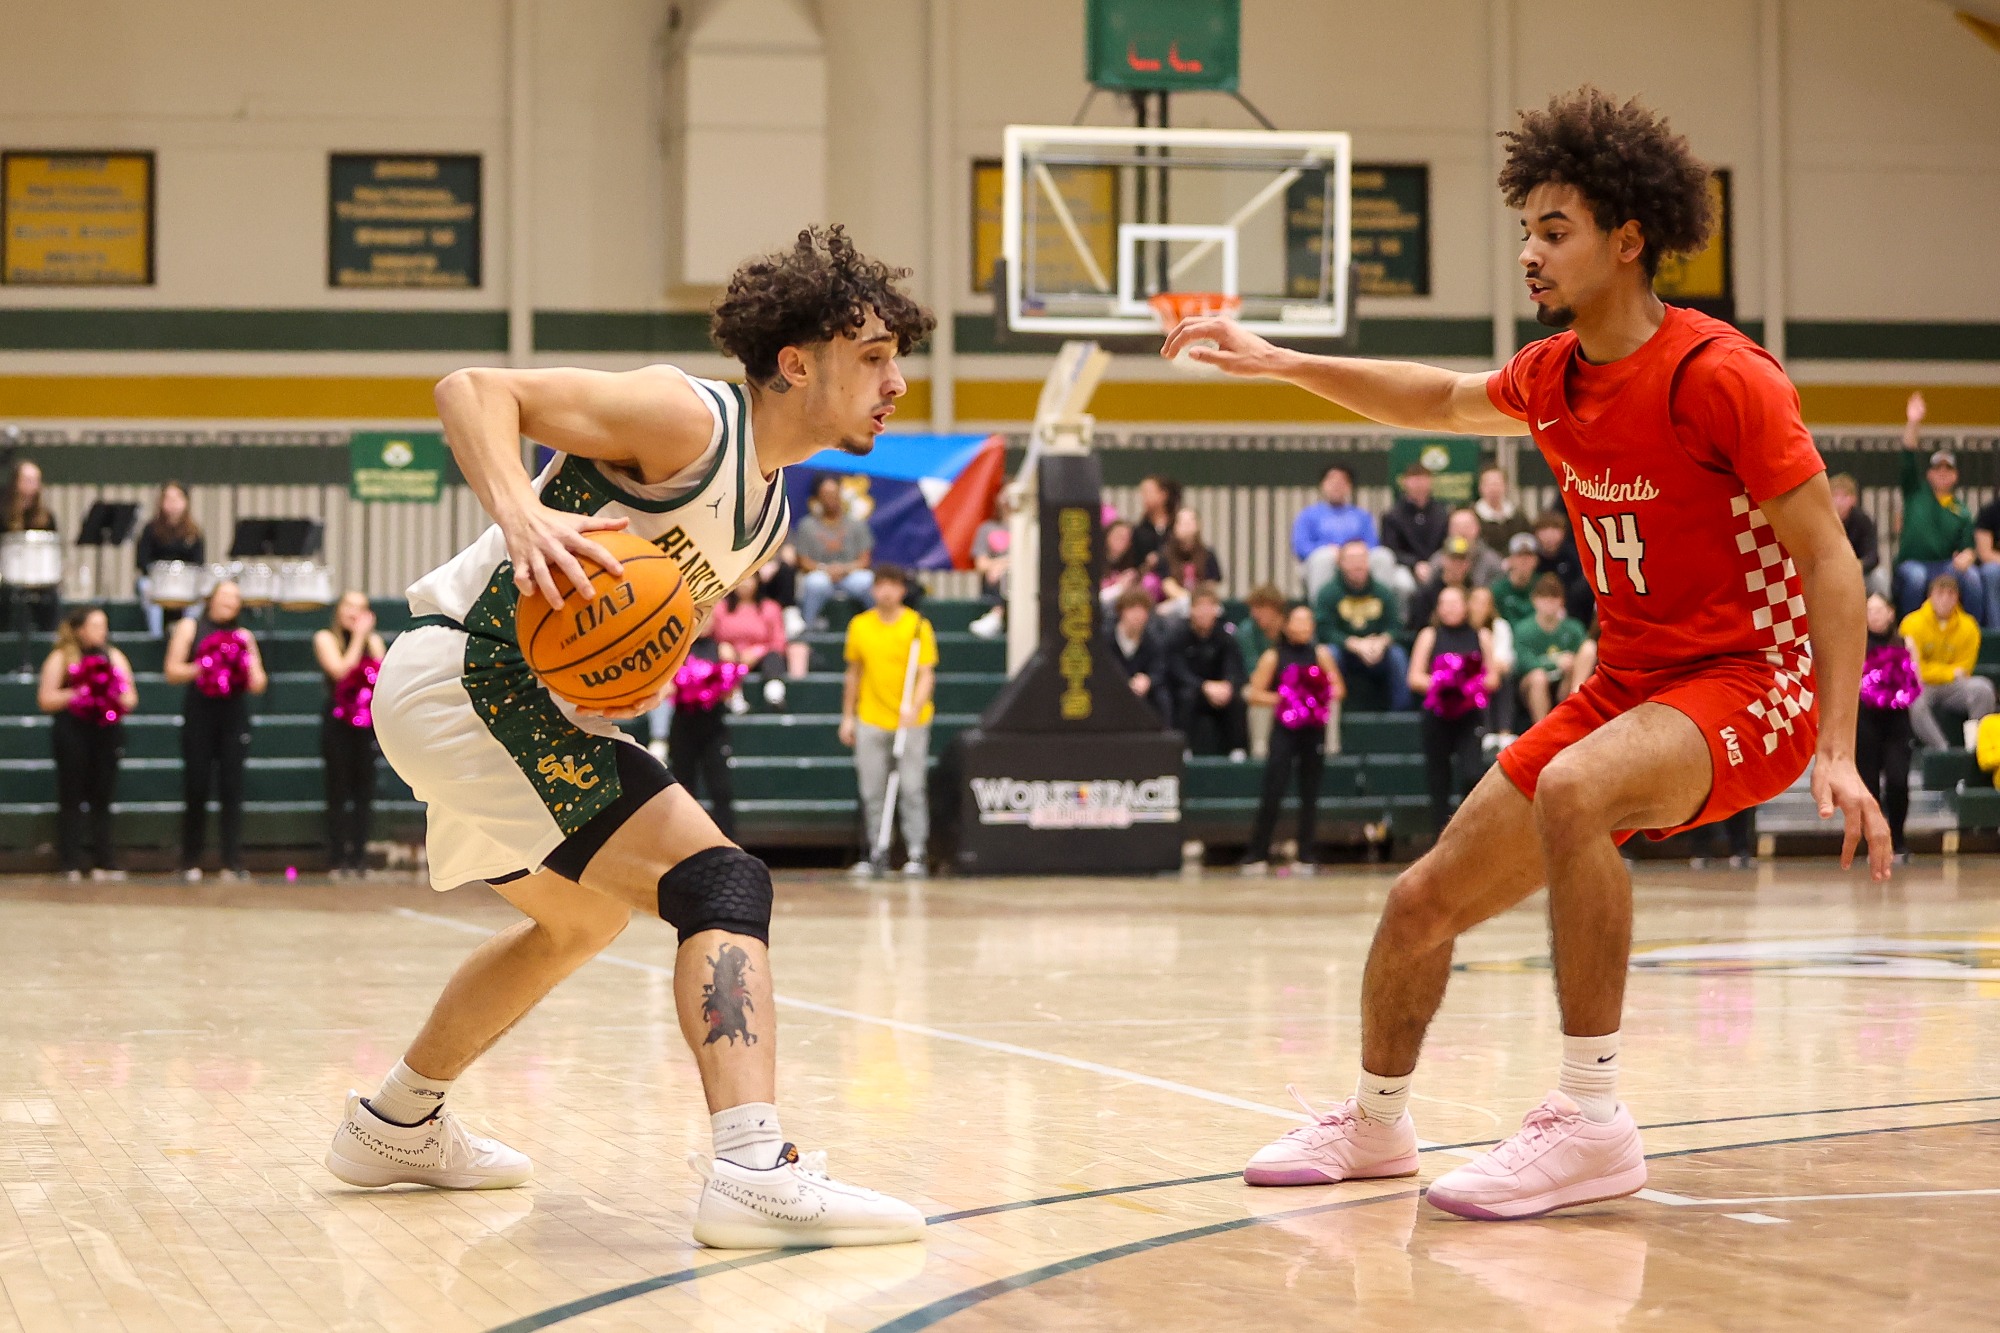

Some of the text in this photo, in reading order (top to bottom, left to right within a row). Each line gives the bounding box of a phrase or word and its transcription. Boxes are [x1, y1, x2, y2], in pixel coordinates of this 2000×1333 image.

[1562, 461, 1660, 502] Presidents
[1582, 513, 1649, 596] 14
[579, 614, 685, 687] Wilson
